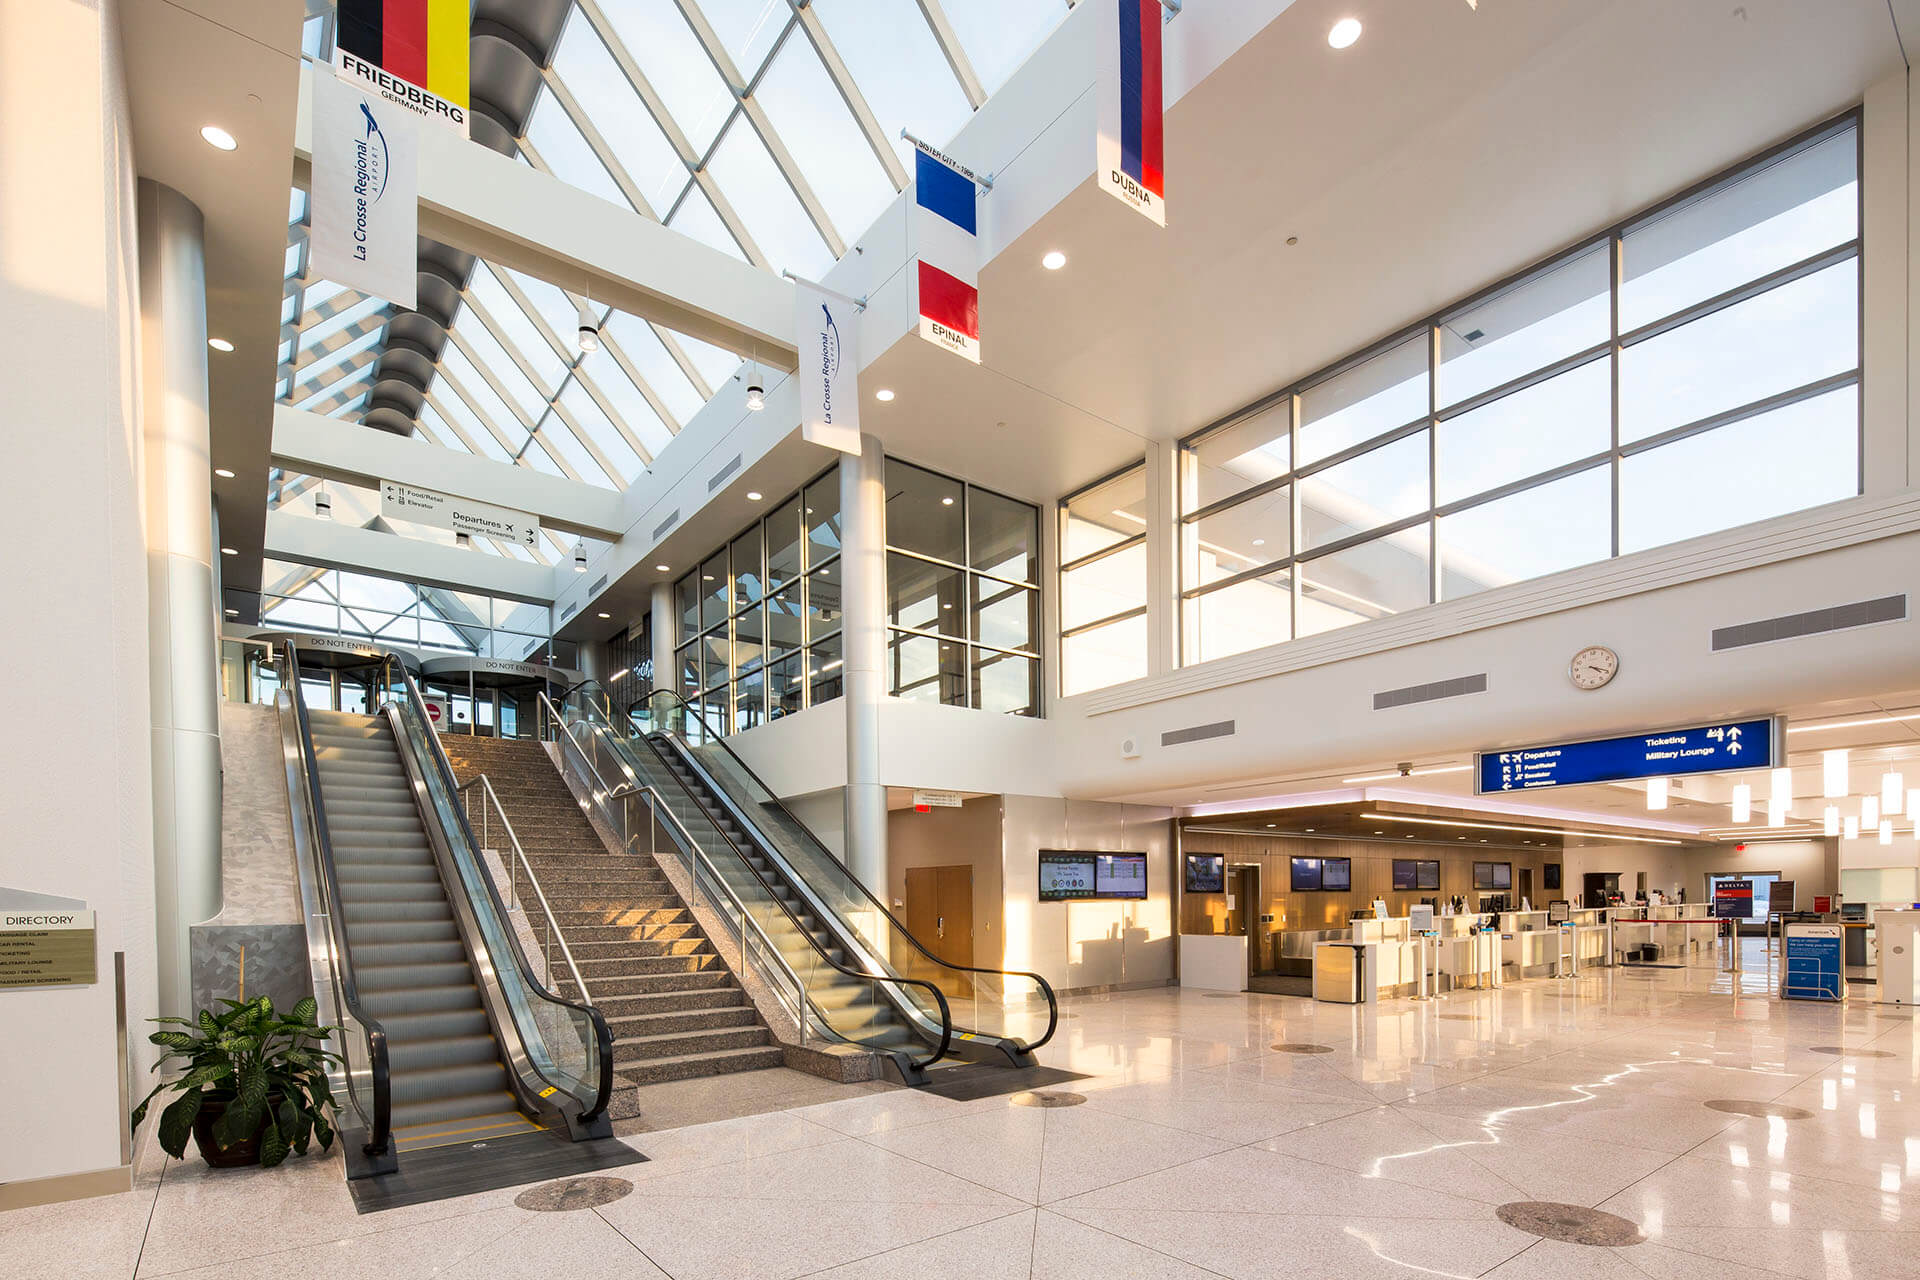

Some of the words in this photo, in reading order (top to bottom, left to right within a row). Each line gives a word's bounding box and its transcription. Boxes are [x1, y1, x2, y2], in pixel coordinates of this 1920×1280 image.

[343, 55, 464, 124] FRIEDBERG
[381, 90, 429, 117] GERMANY
[919, 140, 941, 159] SISTER
[942, 155, 957, 168] CITY
[354, 139, 370, 196] Regional
[371, 146, 379, 193] AIRPORT
[1112, 170, 1151, 206] DUBNA
[353, 199, 367, 243] Crosse
[353, 245, 367, 262] La
[932, 323, 968, 348] EPINAL
[821, 332, 831, 376] Regional
[823, 377, 831, 411] Crosse
[824, 413, 832, 425] La
[407, 490, 444, 503] Food/Retail
[407, 499, 433, 510] Elevator
[452, 511, 502, 529] Departures
[452, 521, 485, 533] Passenger
[486, 528, 516, 541] Screening
[311, 638, 325, 646] DO
[326, 639, 346, 648] NOT
[347, 641, 374, 652] ENTER
[499, 662, 515, 670] NOT
[516, 664, 537, 674] ENTER
[1645, 736, 1687, 747] Ticketing
[1524, 750, 1562, 760] Departure
[1645, 751, 1679, 761] Military
[1680, 747, 1715, 757] Lounge
[6, 915, 74, 926] DIRECTORY
